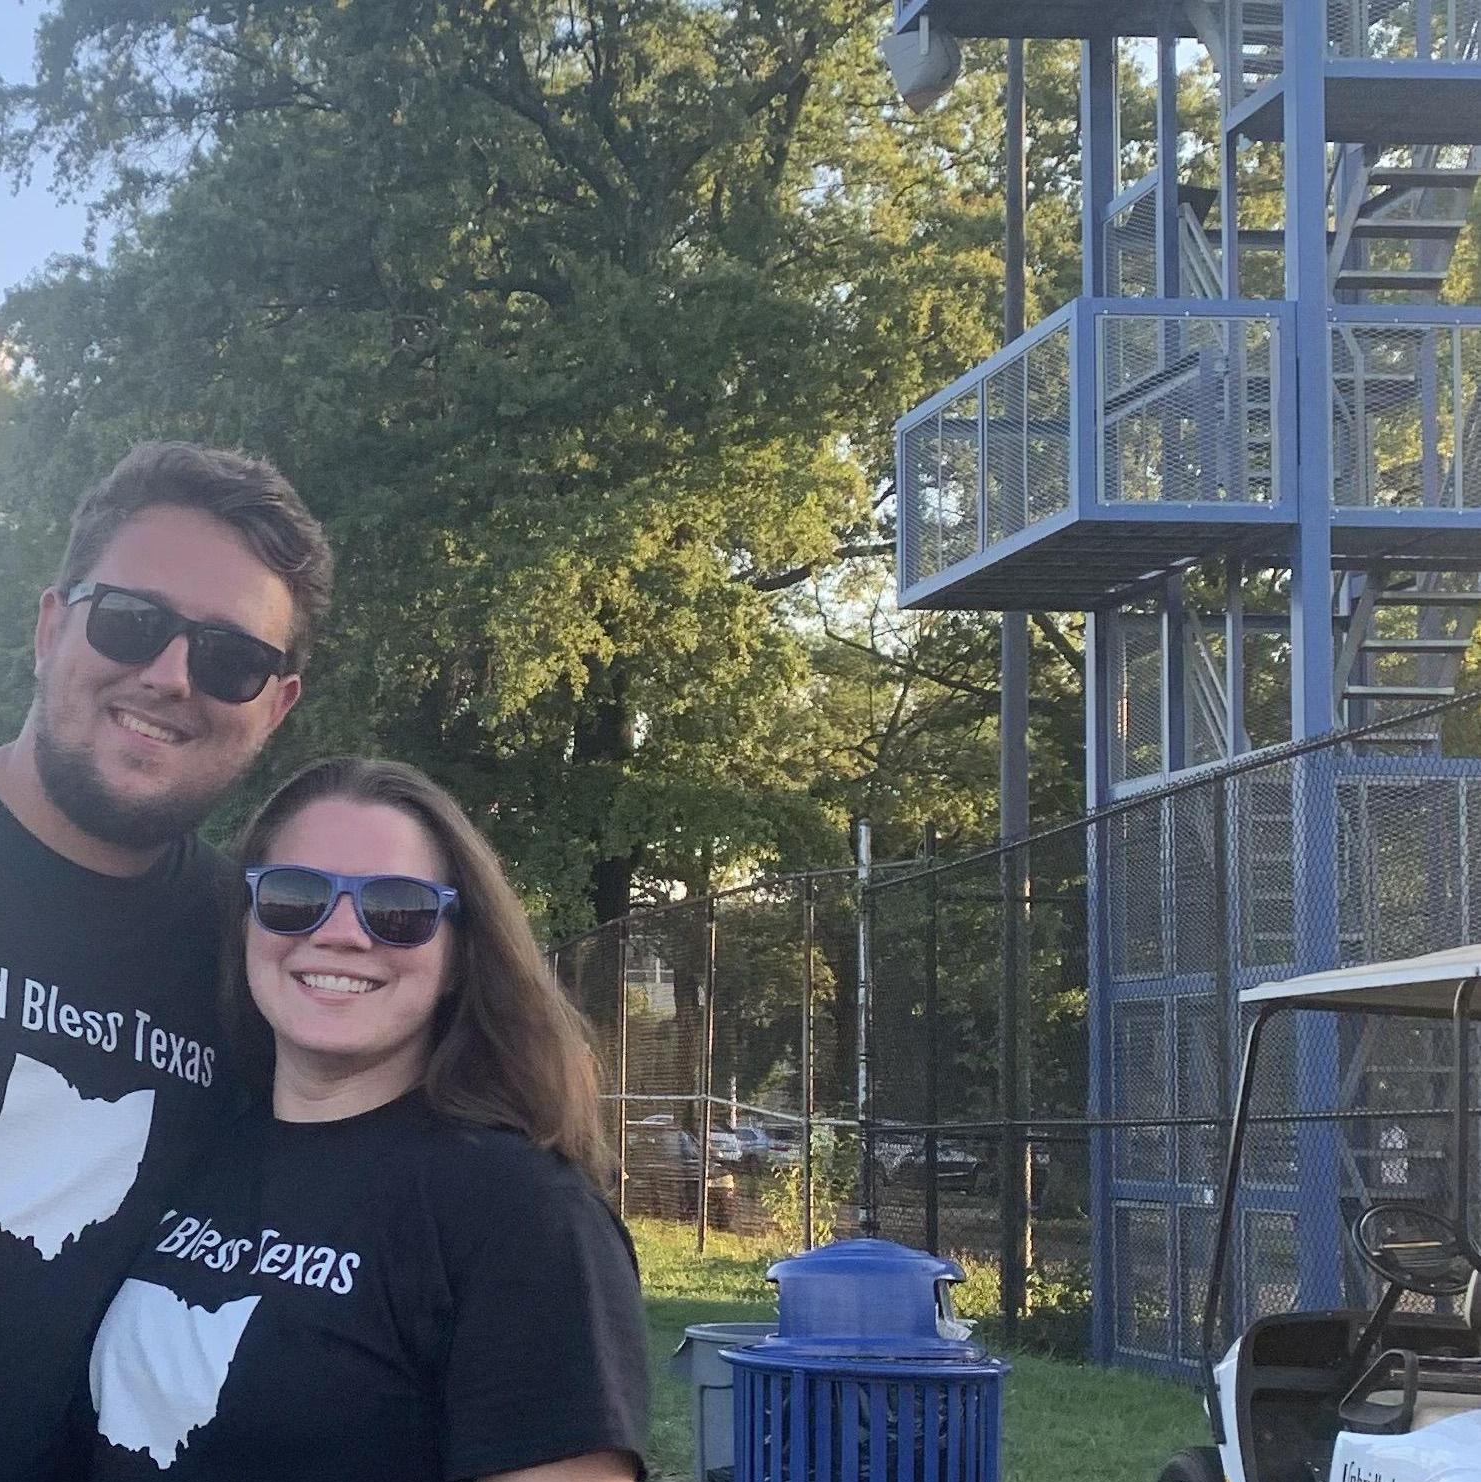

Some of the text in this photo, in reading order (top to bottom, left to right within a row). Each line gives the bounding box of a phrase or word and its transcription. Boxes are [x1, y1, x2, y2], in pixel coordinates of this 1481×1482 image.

[21, 978, 124, 1052] Bless
[134, 1009, 216, 1088] Texas
[156, 1217, 361, 1295] Bless Texas
